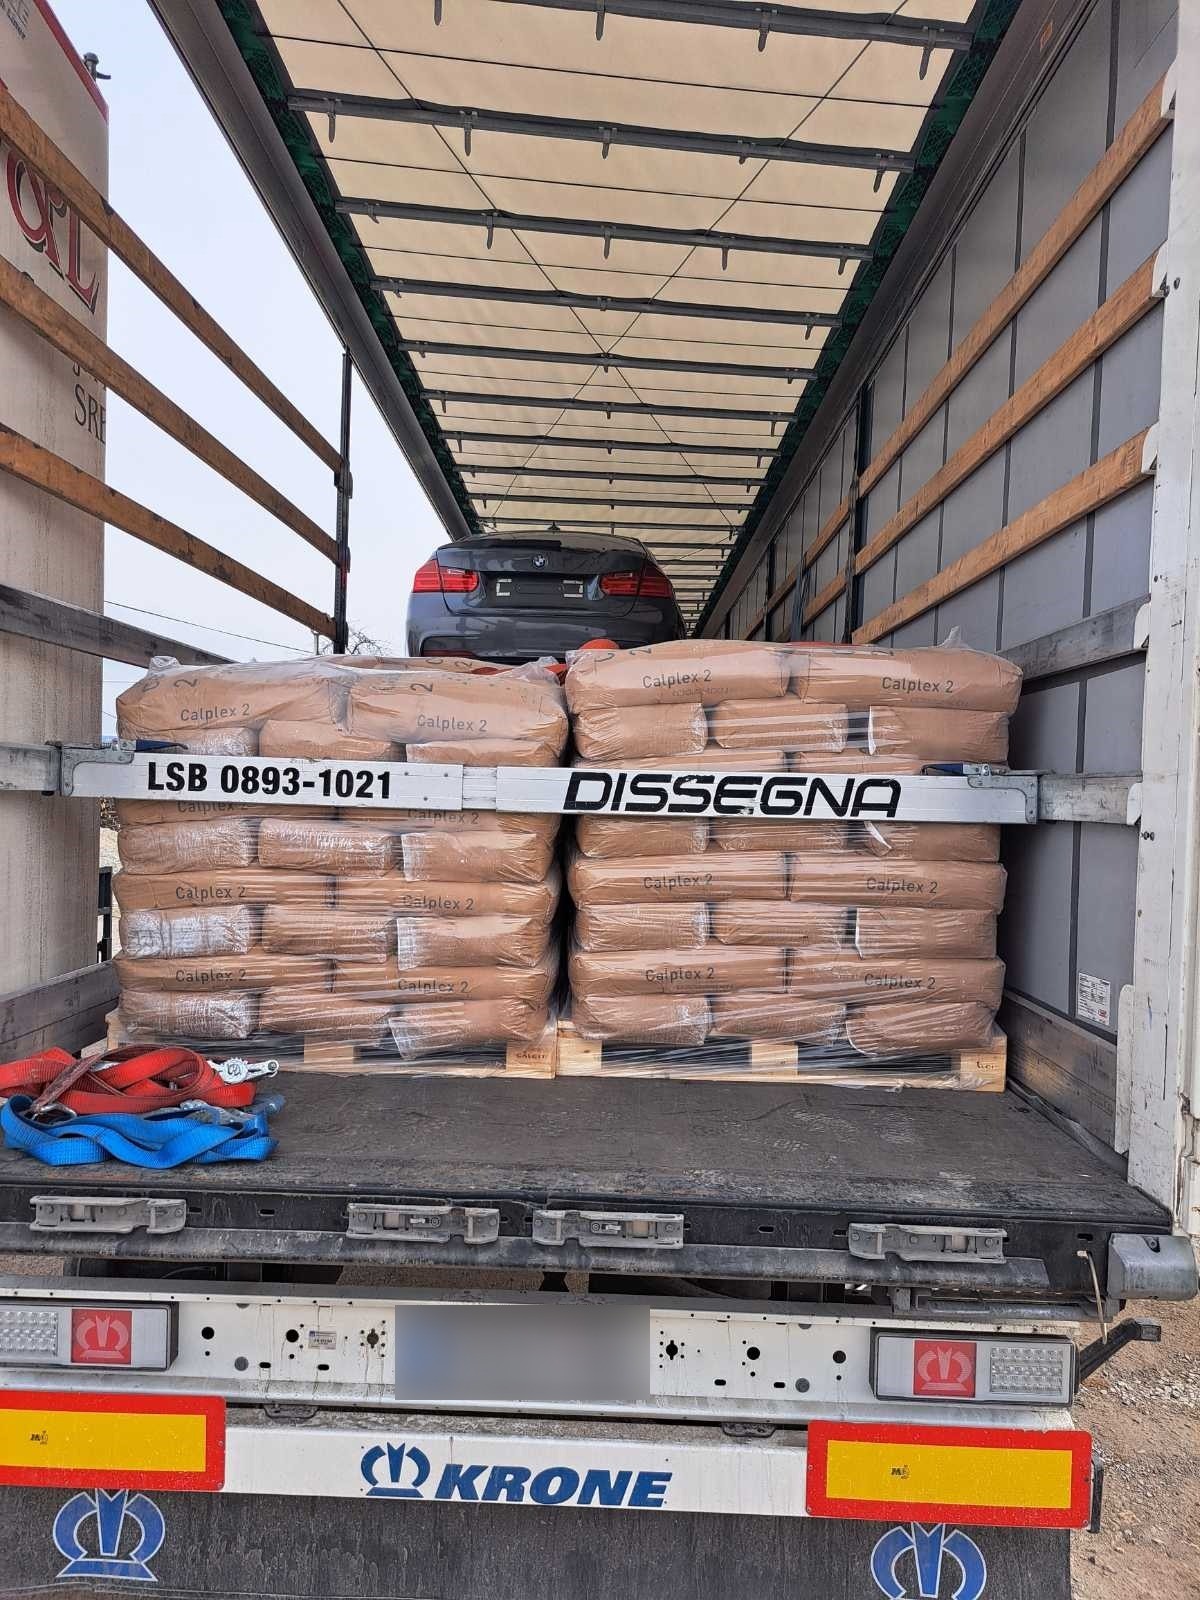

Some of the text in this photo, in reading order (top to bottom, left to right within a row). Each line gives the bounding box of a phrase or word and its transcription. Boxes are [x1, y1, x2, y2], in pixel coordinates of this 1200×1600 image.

[643, 669, 712, 689] Calplex 2
[882, 676, 954, 694] Calplex 2
[181, 703, 250, 724] Calplex 2
[417, 714, 487, 732] Calplex 2
[147, 762, 390, 799] LSB 0893-1021
[563, 772, 902, 817] DISSEGNA
[408, 808, 479, 824] Calplex 2
[644, 873, 713, 891] Calplex 2
[867, 877, 938, 894] Calplex 2
[176, 885, 247, 901] Calplex 2
[403, 895, 474, 910] Calplex 2
[176, 968, 247, 984] Calplex 2
[646, 967, 714, 983] Calplex 2
[865, 973, 936, 989] Calplex 2
[460, 981, 468, 993] 2
[435, 1464, 672, 1507] KRONE
